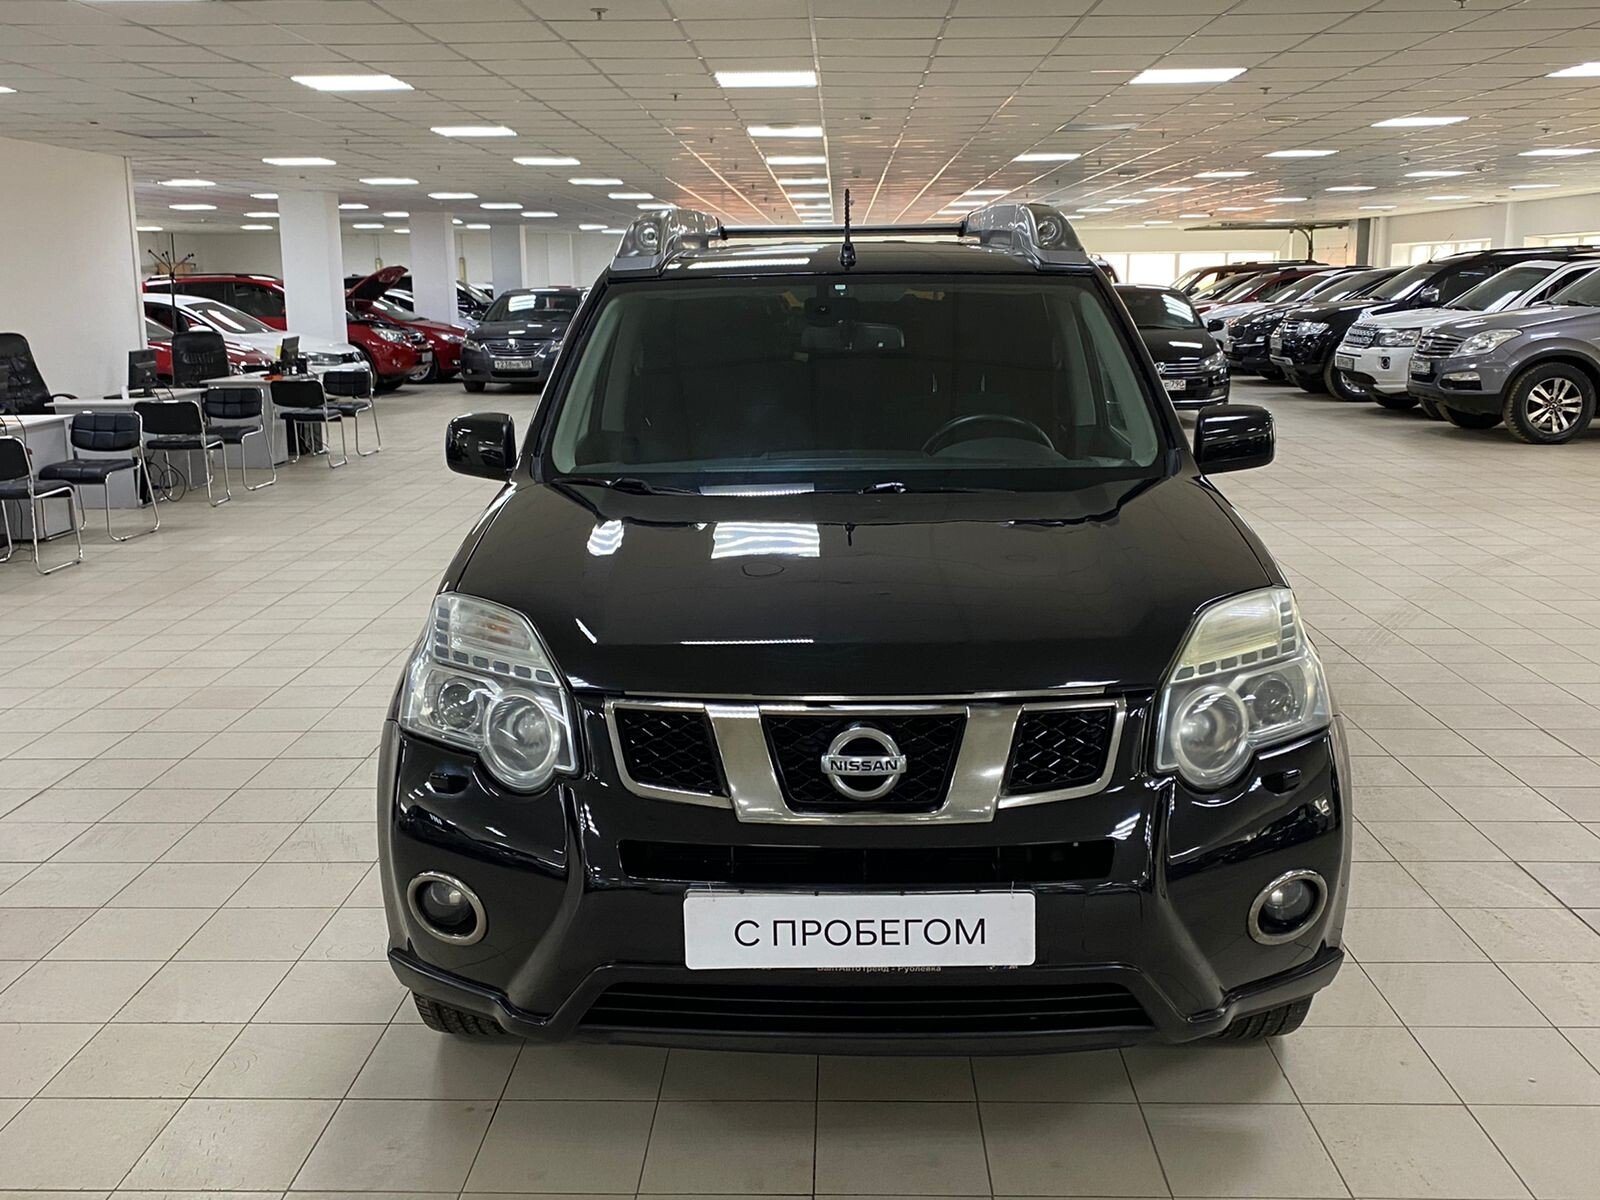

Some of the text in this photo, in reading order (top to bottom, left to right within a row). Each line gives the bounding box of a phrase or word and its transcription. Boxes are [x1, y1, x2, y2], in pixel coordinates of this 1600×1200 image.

[830, 759, 898, 772] NISSAN
[734, 918, 985, 946] С ПРОБЕГОМ
